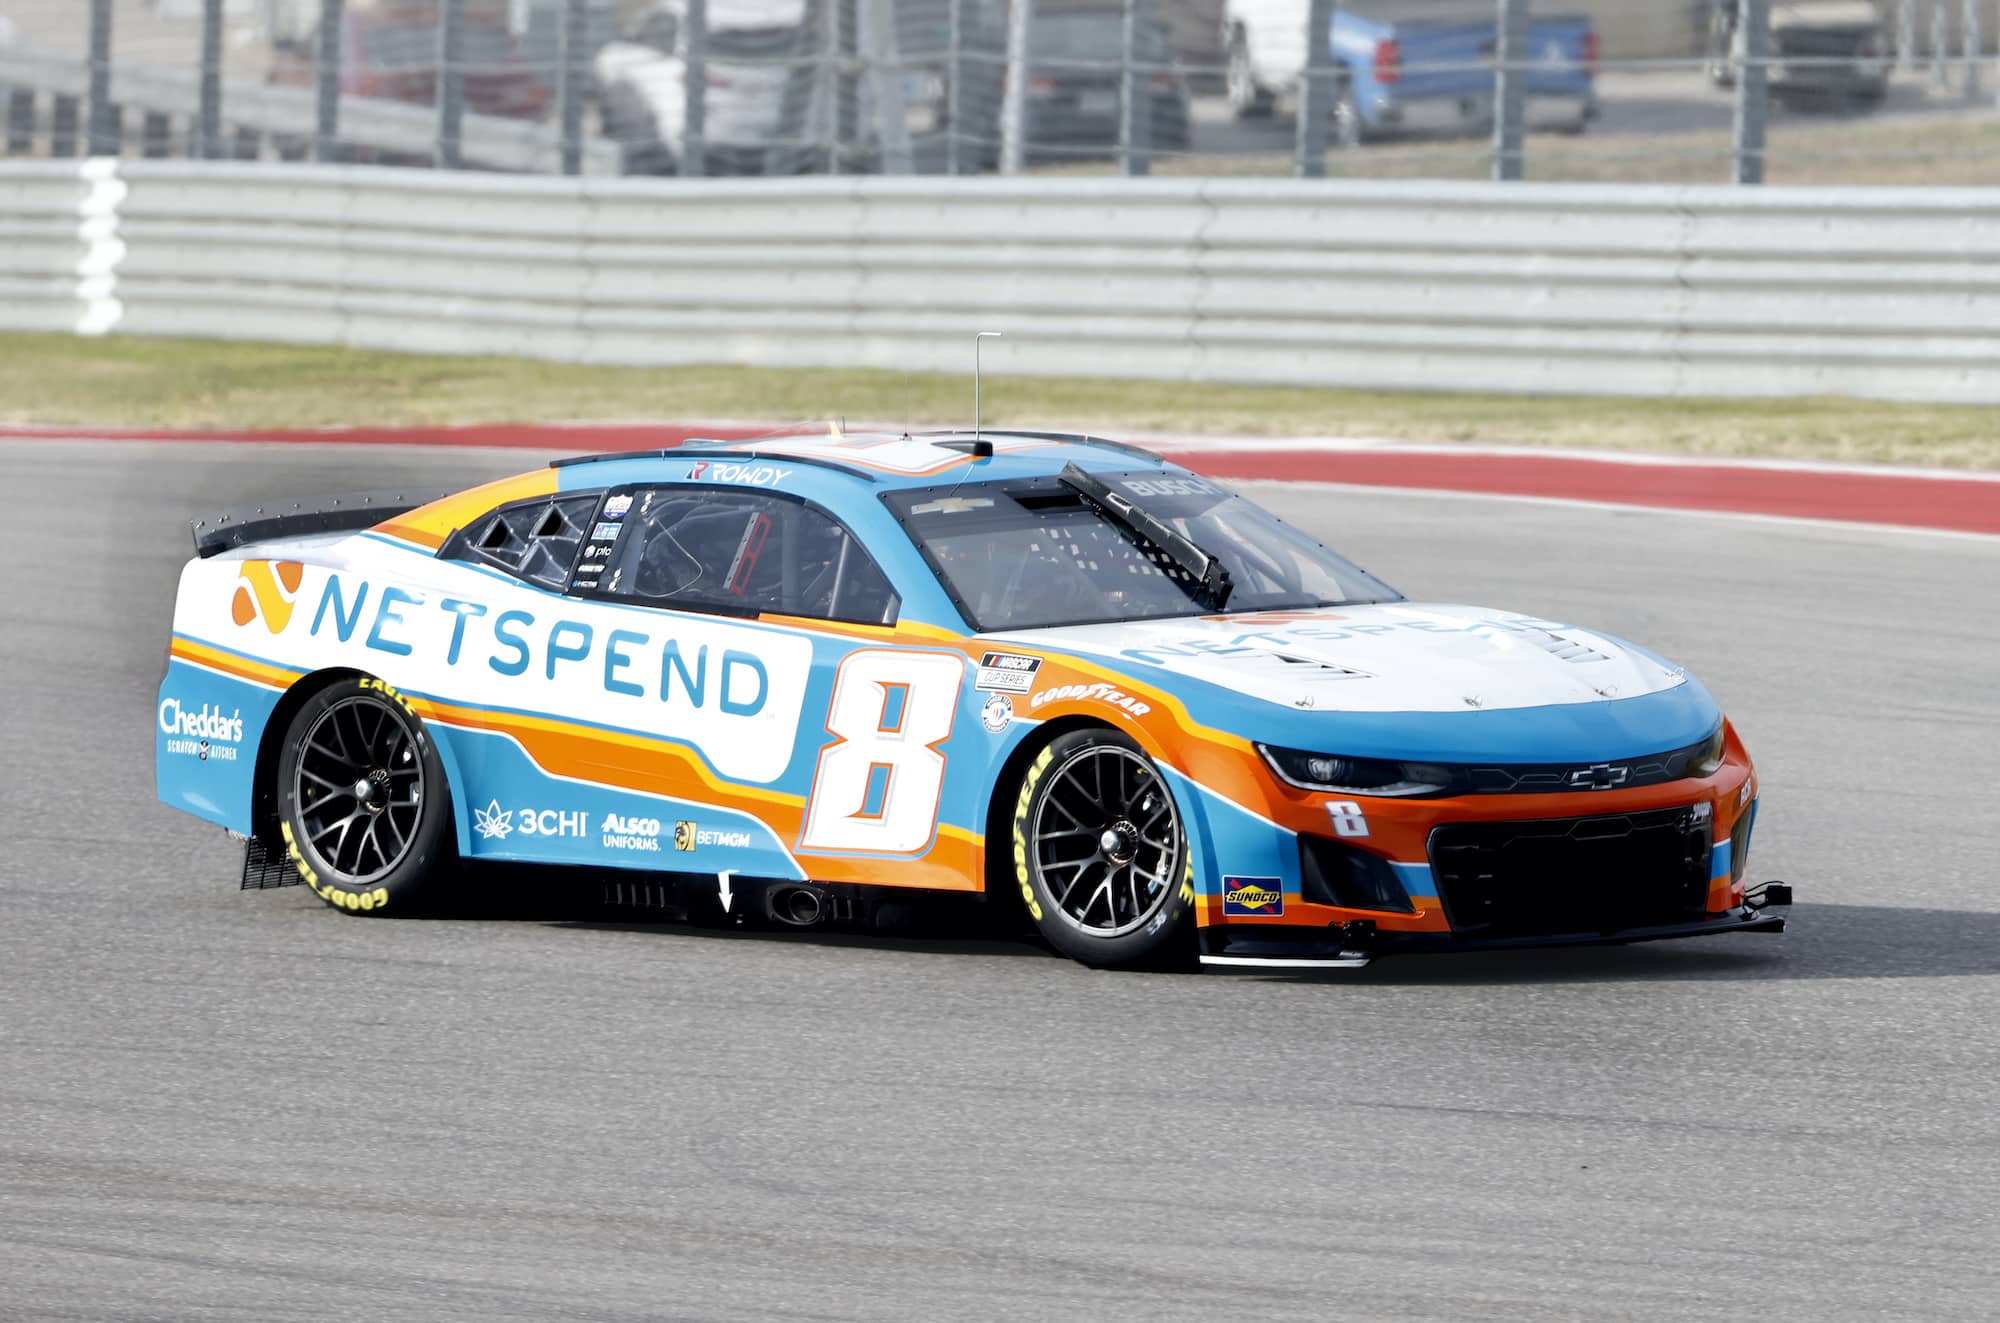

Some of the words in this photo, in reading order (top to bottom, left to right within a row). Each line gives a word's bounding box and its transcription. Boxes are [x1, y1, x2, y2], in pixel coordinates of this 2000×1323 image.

[712, 463, 792, 487] ROWDY
[1121, 479, 1222, 496] BUSCH
[310, 574, 768, 718] NETSPEND
[983, 671, 1002, 682] CUP
[1001, 673, 1027, 685] SERIES
[358, 677, 416, 716] EAGLE
[1031, 683, 1151, 716] GOODYEAR
[159, 698, 243, 742] Cheddar's
[799, 649, 965, 854] 8
[518, 809, 586, 838] 3CHI
[602, 813, 660, 836] ALSCO
[1013, 745, 1054, 921] GOODYEAR
[1325, 799, 1370, 837] 8
[698, 831, 750, 848] BETMGM
[1228, 891, 1278, 903] SUNOCO
